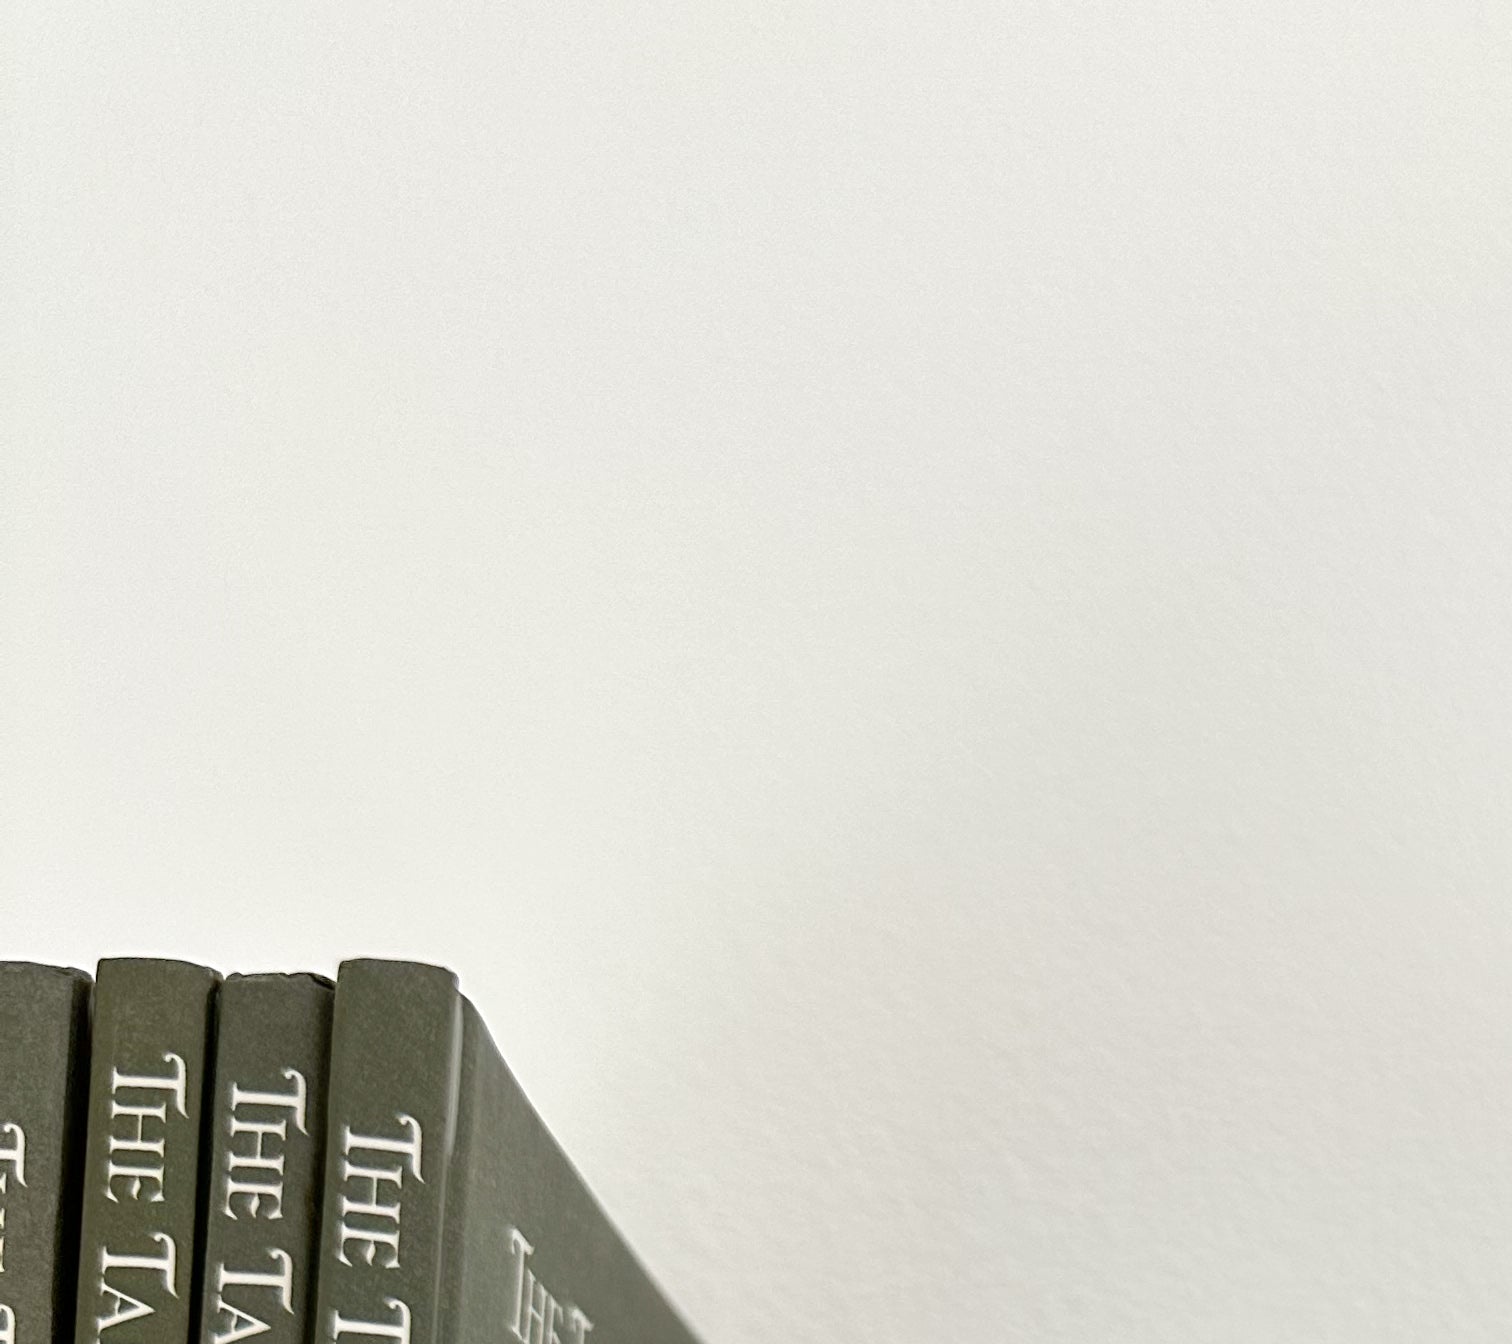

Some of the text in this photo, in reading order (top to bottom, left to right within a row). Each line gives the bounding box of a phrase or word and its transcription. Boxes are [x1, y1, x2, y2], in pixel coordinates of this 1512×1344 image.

[106, 1053, 188, 1202] THE
[224, 1069, 307, 1219] THE
[338, 1115, 424, 1268] THE
